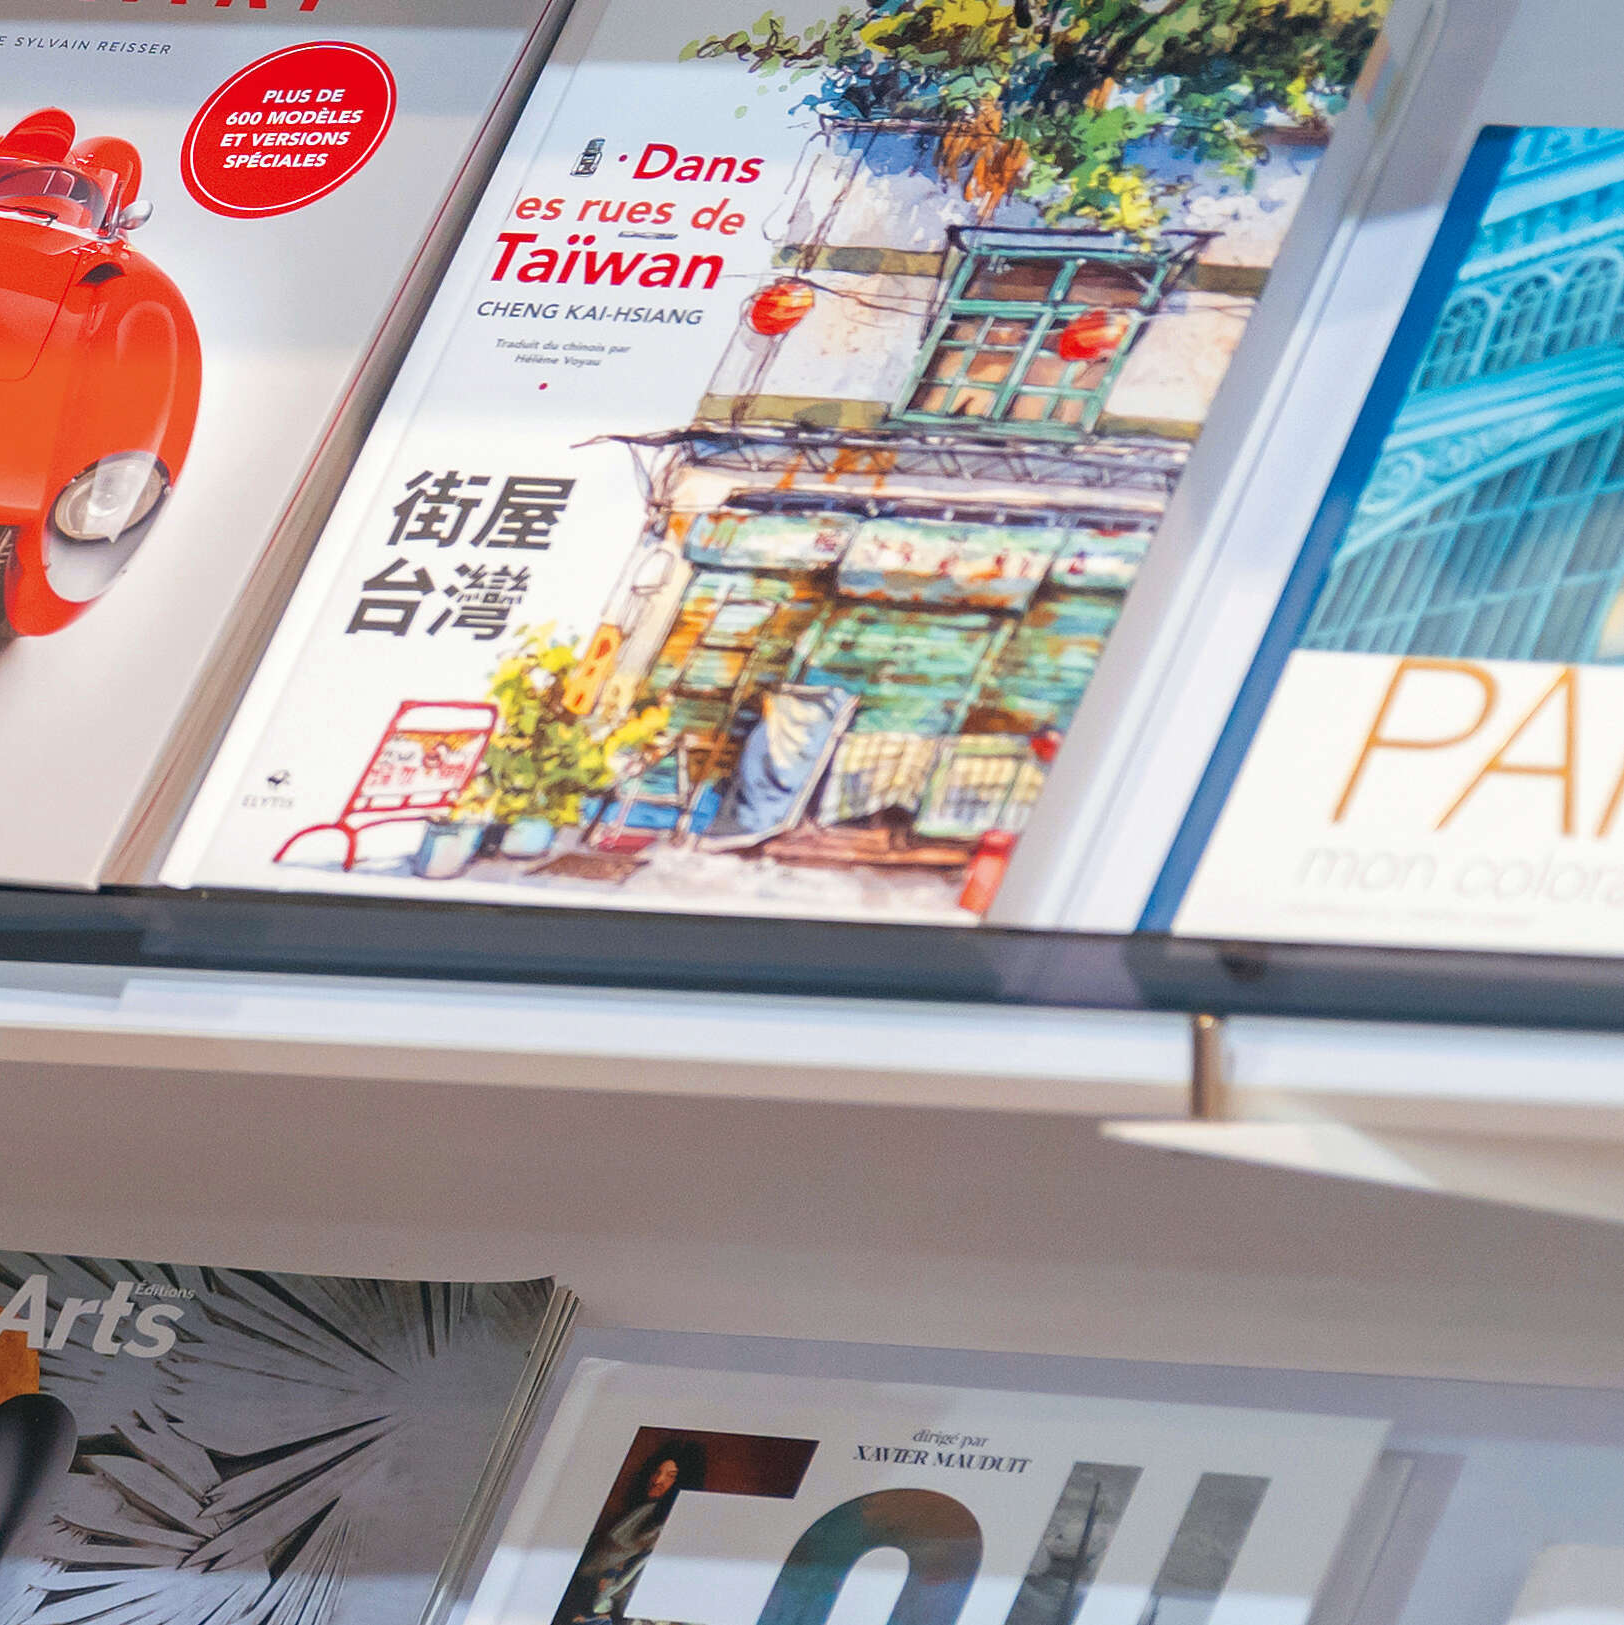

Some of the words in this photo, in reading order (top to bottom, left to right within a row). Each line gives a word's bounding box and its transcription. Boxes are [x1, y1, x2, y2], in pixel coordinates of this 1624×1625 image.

[13, 34, 92, 53] SYLVAIN
[97, 40, 172, 56] REISSER
[262, 87, 313, 105] PLUS
[316, 87, 346, 105] DE
[224, 109, 263, 126] 600
[265, 105, 364, 126] MODÈLES
[220, 131, 249, 148] ET
[251, 130, 350, 148] VERSIONS
[223, 150, 328, 169] SPÉCIALES
[632, 142, 765, 184] Dans
[576, 196, 677, 225] rues
[690, 197, 746, 236] de
[490, 231, 725, 290] Taïwan
[476, 300, 560, 320] CHENG
[564, 303, 704, 326] KAI-HSIANG
[494, 337, 540, 350] Traduit
[542, 339, 559, 351] du
[562, 341, 605, 353] chinois
[607, 344, 632, 356] par
[386, 469, 577, 551] 街屋
[344, 557, 532, 642] 台灣
[1327, 654, 1624, 840] PA
[912, 1428, 960, 1446] dirigé
[960, 1434, 990, 1449] par
[852, 1444, 931, 1466] XAVIER
[932, 1450, 1034, 1474] MAUDUIT
